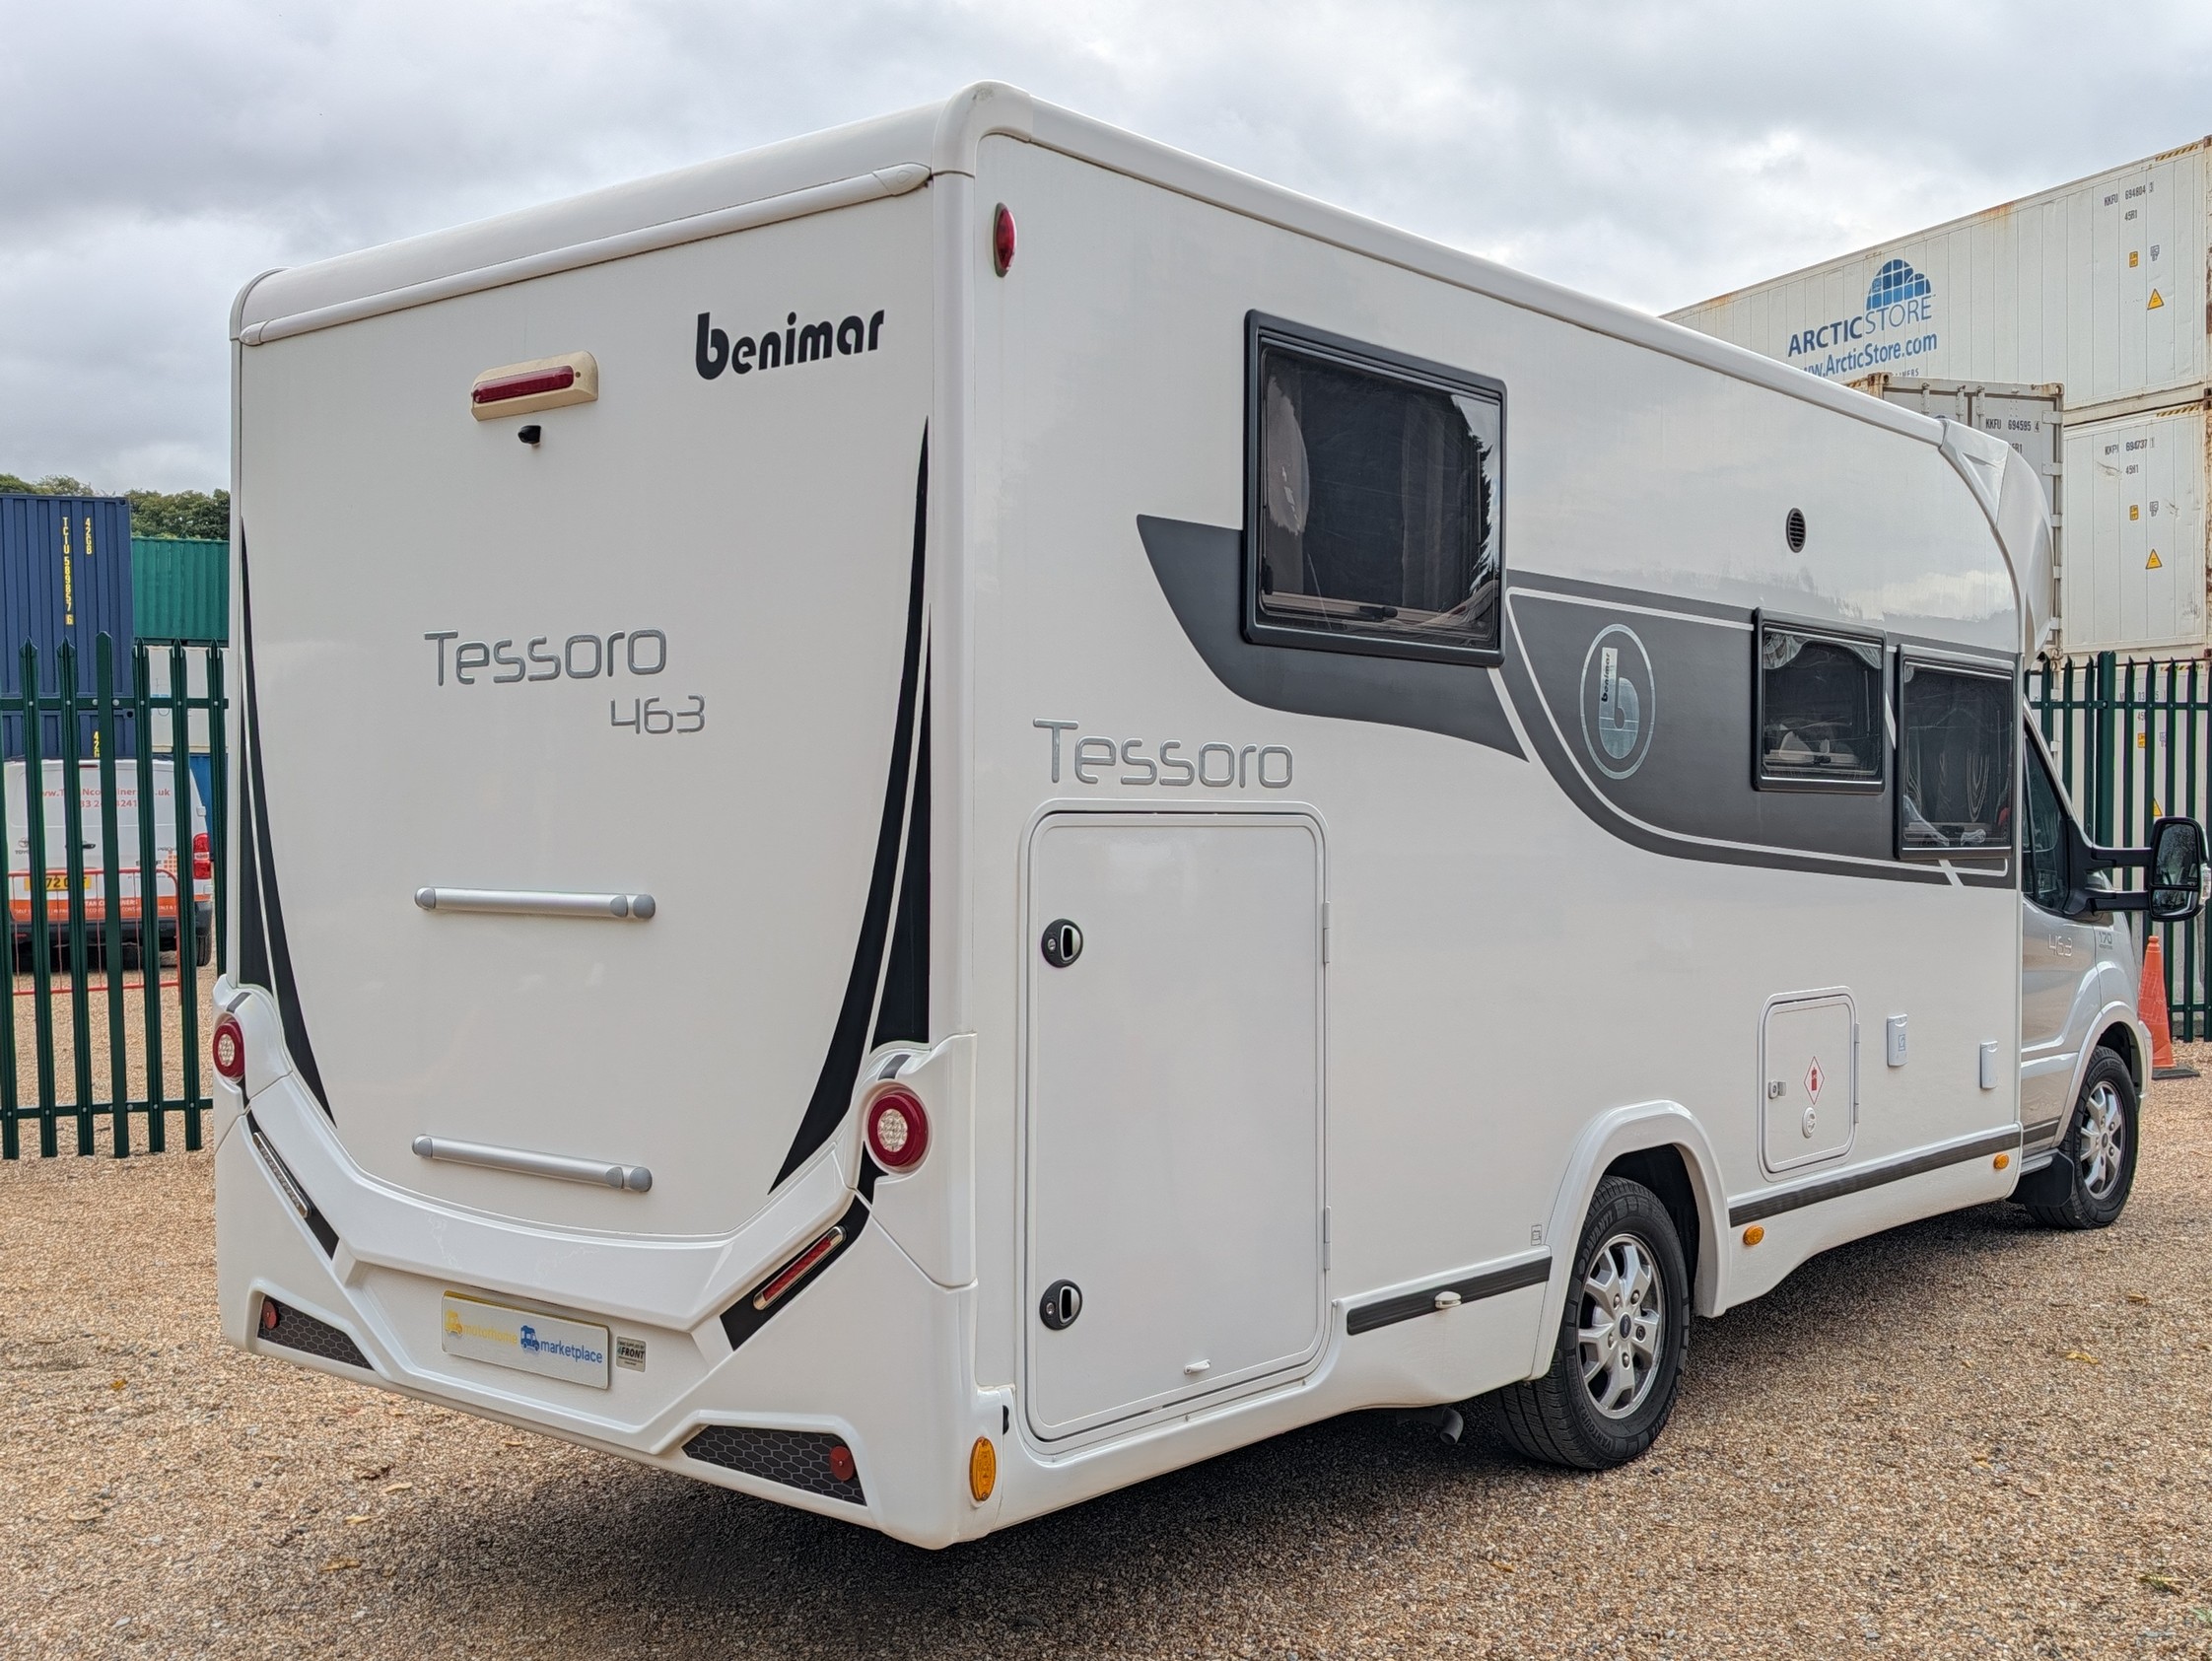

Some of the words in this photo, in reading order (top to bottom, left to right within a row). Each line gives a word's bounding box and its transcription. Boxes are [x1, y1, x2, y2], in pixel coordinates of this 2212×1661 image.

[696, 310, 884, 381] benimar
[1985, 418, 2002, 431] KKFU
[2008, 420, 2032, 432] 694595
[424, 627, 666, 686] Tessoro
[610, 693, 706, 734] 463
[1033, 718, 1293, 789] Tessoro
[2048, 934, 2073, 957] 463
[2099, 931, 2112, 944] 170
[462, 1324, 518, 1346] motorhome
[541, 1340, 603, 1364] marketplace
